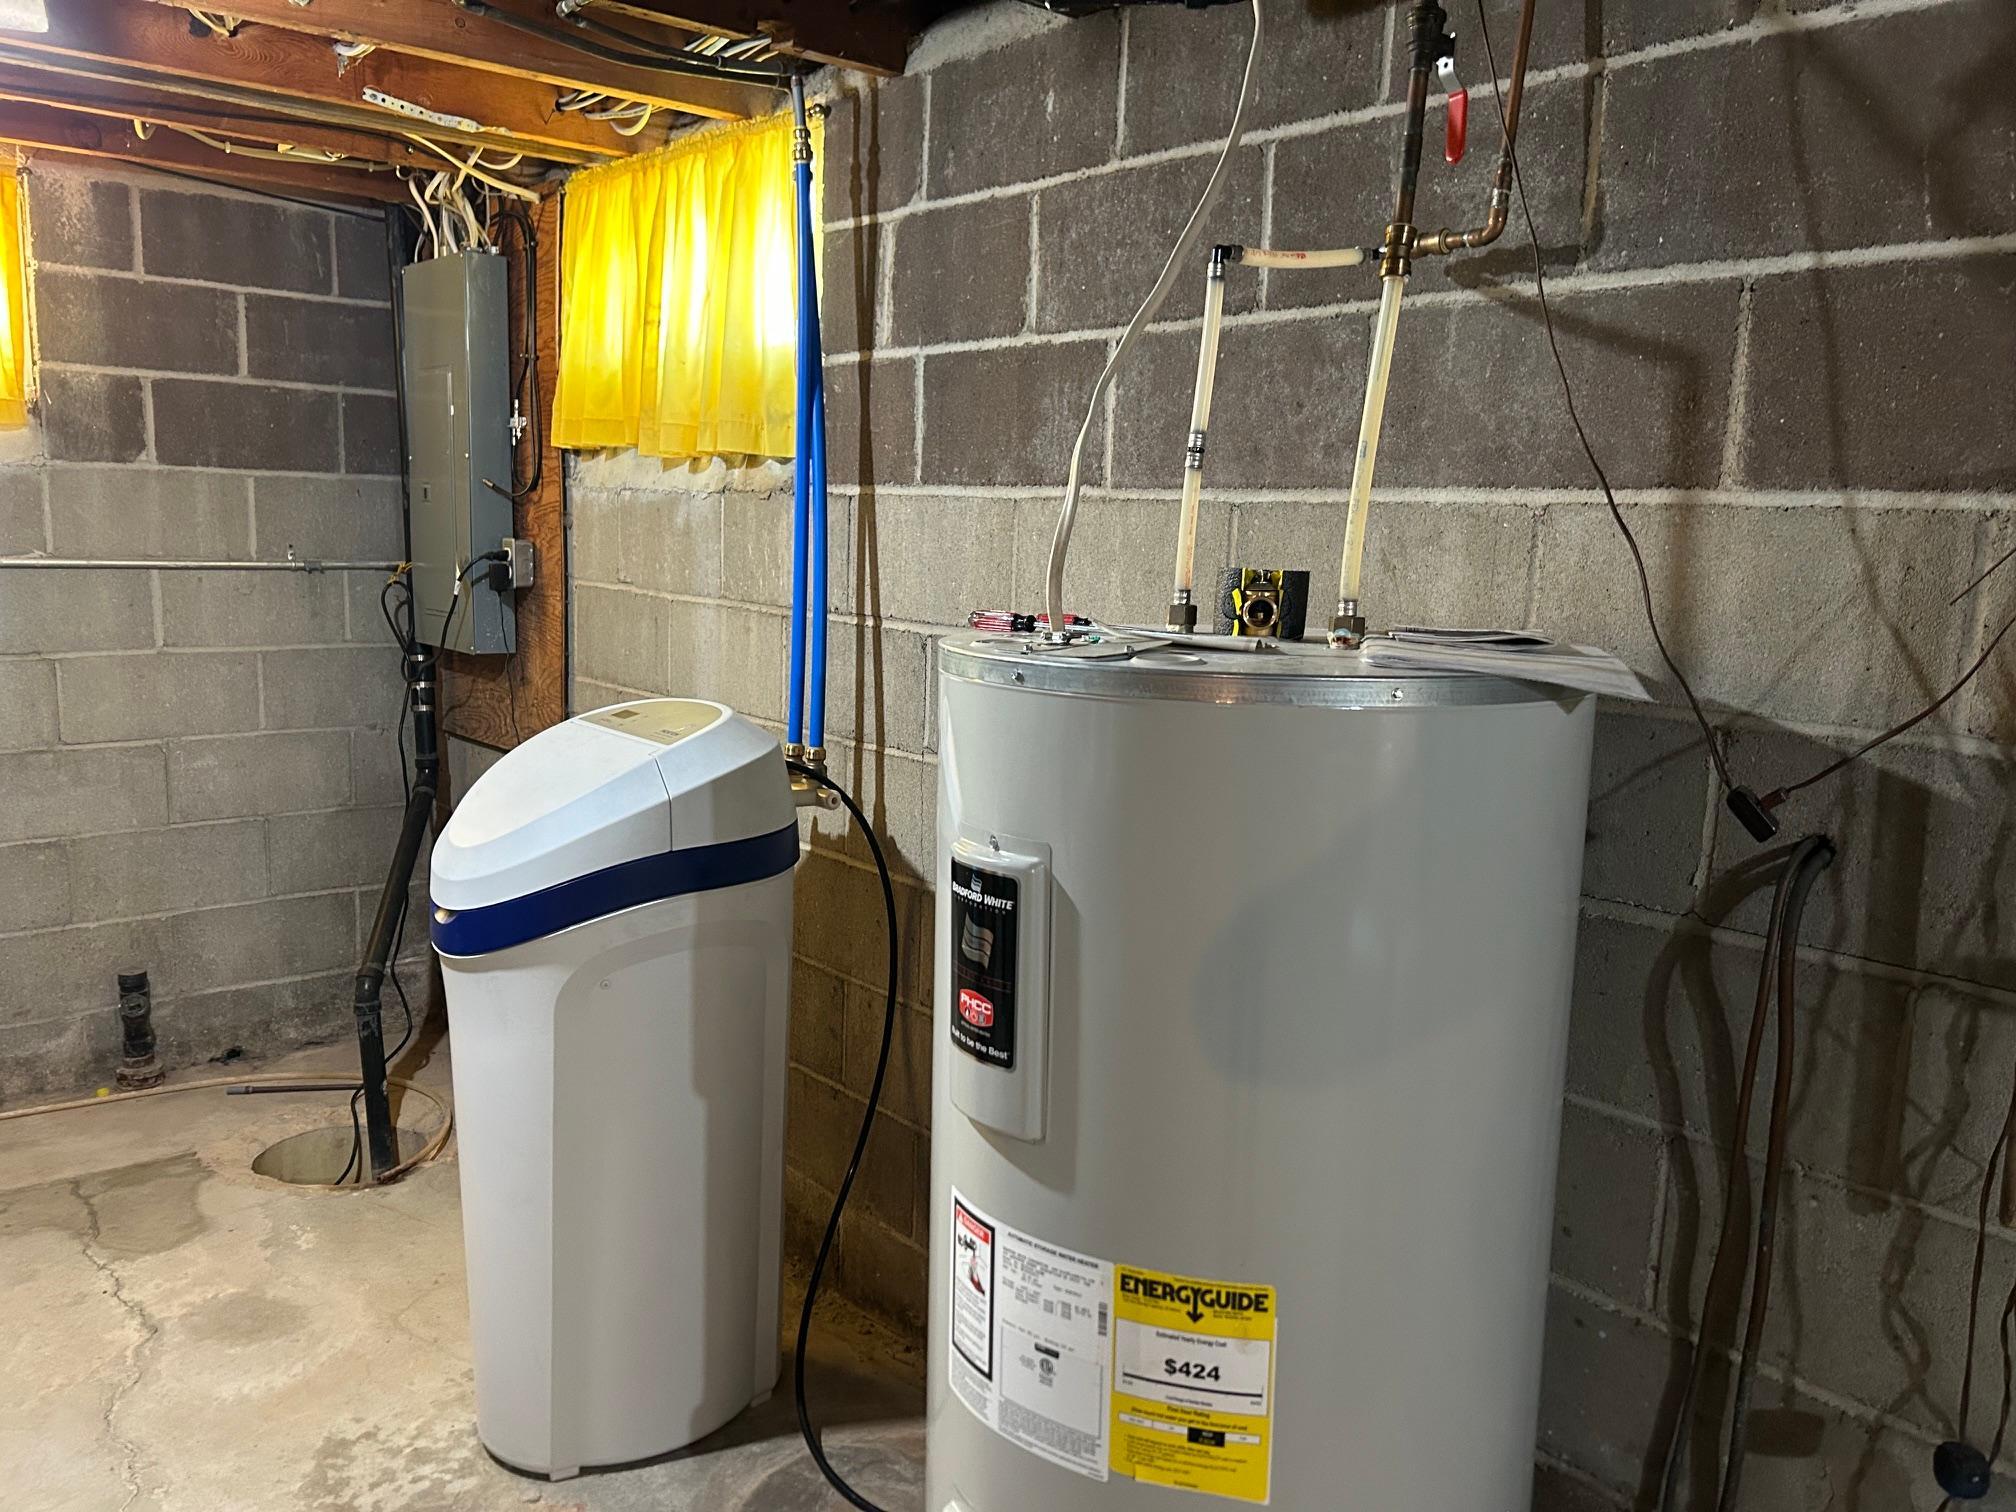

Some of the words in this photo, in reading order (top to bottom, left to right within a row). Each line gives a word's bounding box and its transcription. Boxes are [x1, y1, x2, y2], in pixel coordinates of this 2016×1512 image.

[952, 880, 983, 903] BRADFORD
[984, 894, 1015, 911] WHITE
[960, 992, 992, 1015] PHCC
[975, 1042, 987, 1053] the
[988, 1046, 1008, 1060] Best
[1120, 1273, 1269, 1314] ENERGYGUIDE
[1164, 1358, 1221, 1382] $424
